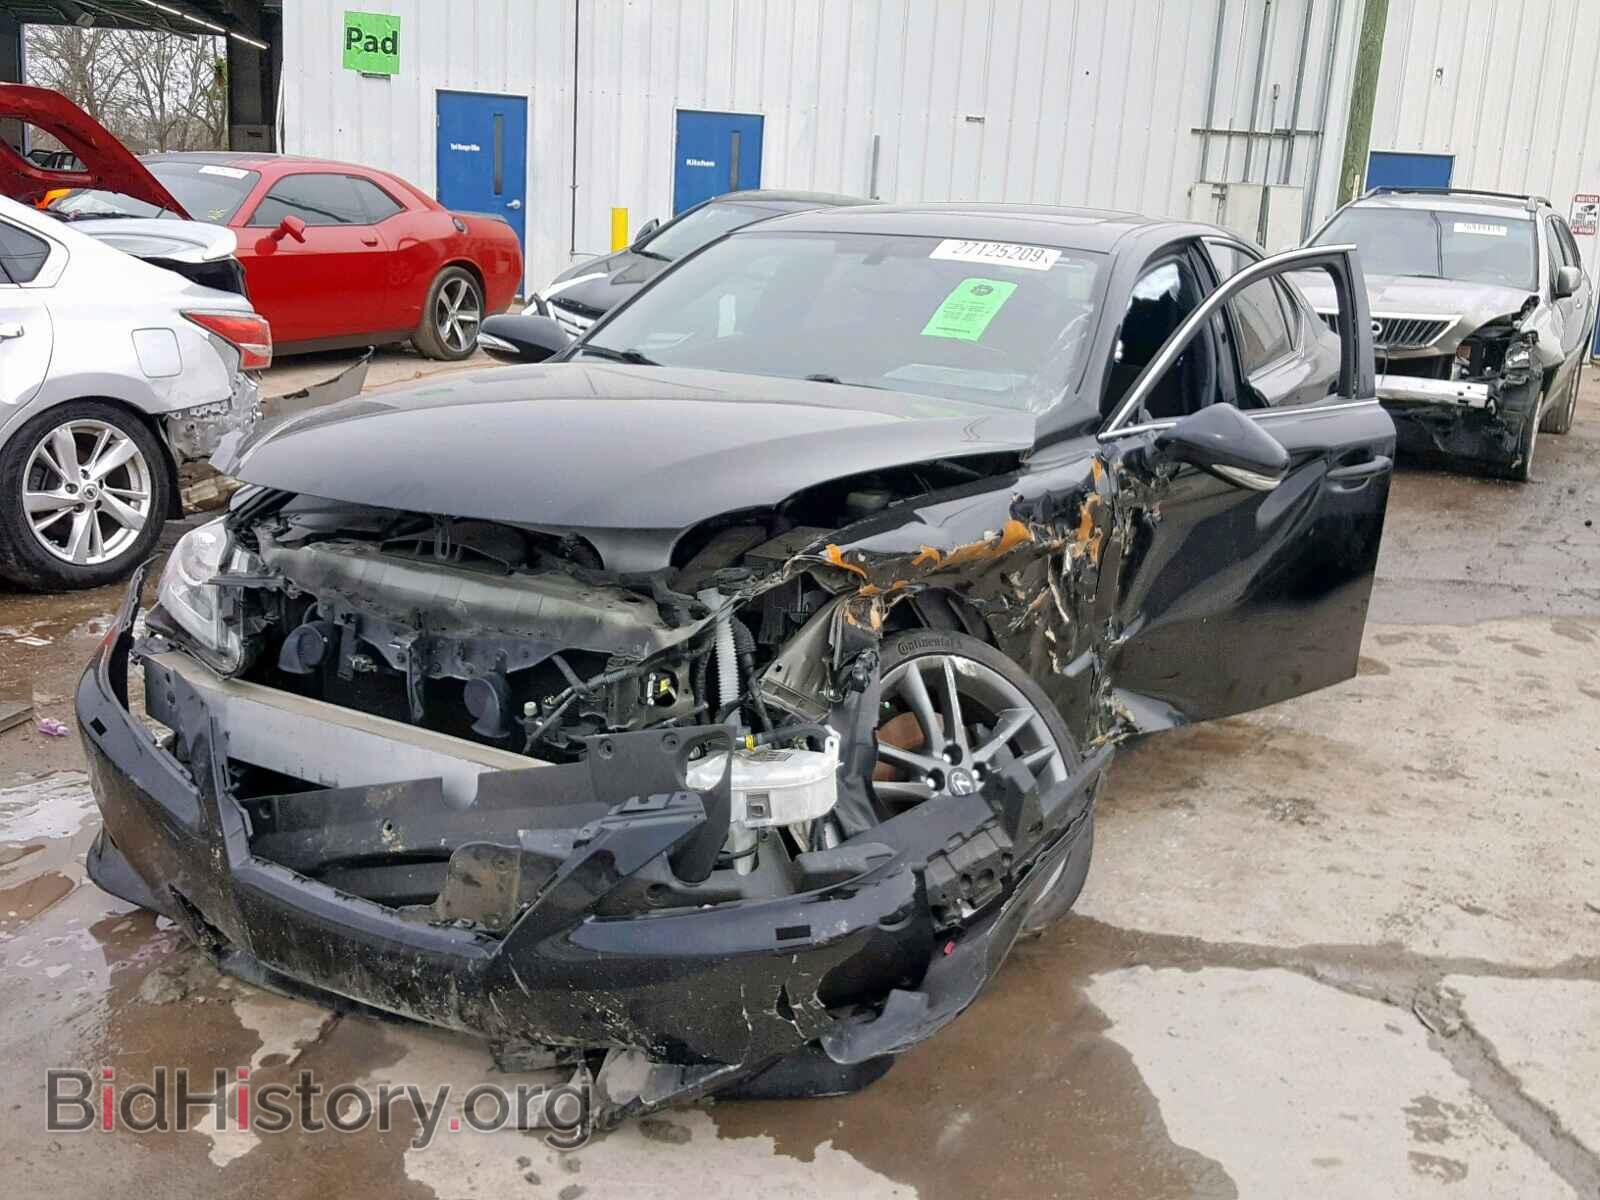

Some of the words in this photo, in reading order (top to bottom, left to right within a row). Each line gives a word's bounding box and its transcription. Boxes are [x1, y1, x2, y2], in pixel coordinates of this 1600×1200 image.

[345, 27, 398, 55] Pad
[686, 158, 716, 168] Kitchen
[950, 240, 1046, 263] 27125209
